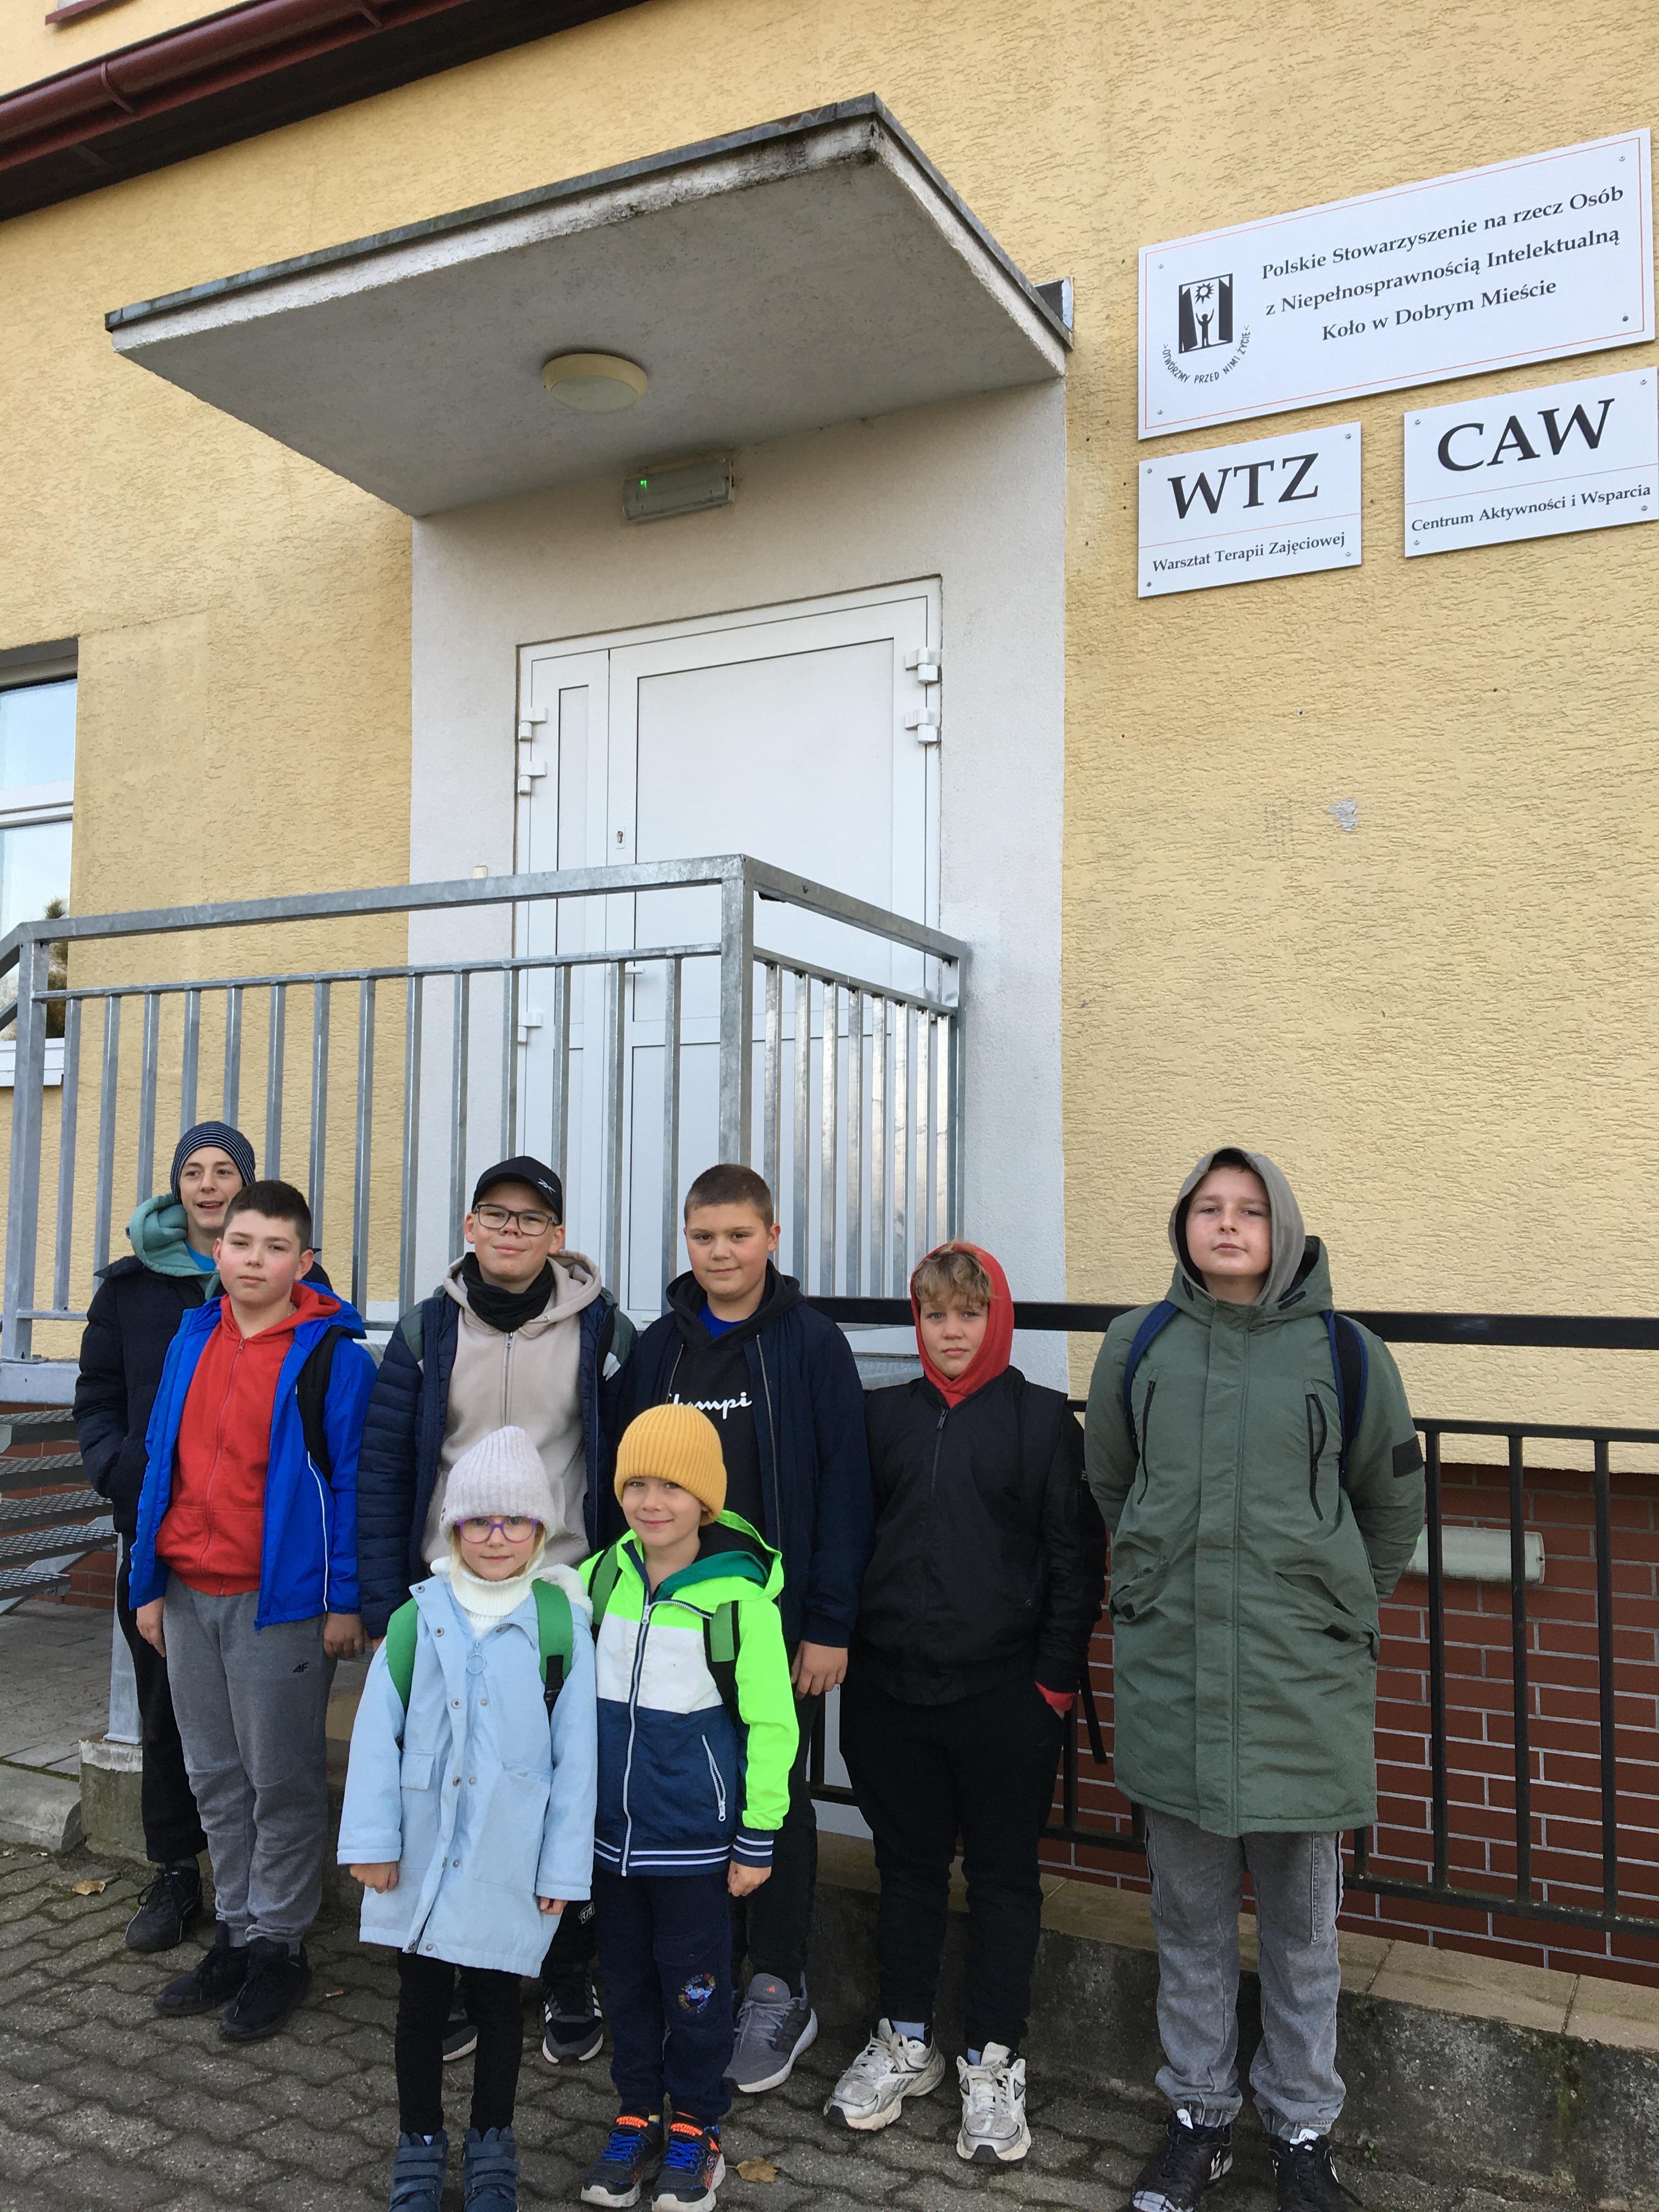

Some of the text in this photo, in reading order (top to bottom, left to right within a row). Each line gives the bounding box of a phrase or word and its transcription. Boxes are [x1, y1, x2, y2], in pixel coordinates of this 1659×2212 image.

[1262, 185, 1623, 280] Polskie Stowarzyszenie na rzecz Osób
[1266, 229, 1620, 315] z Niepełnosprawnością Intelektualną
[1322, 280, 1556, 341] Koło w Dobrym Mieście
[1163, 331, 1251, 383] OTWÓRZMY PRZED NIMI ŻYCIE
[1437, 398, 1615, 472] CAW
[1167, 453, 1319, 520] WTZ
[1412, 484, 1651, 531] Centrum Aktywności i Wsparcia
[1153, 531, 1345, 572] Warsztat Terapii Zajęciowej
